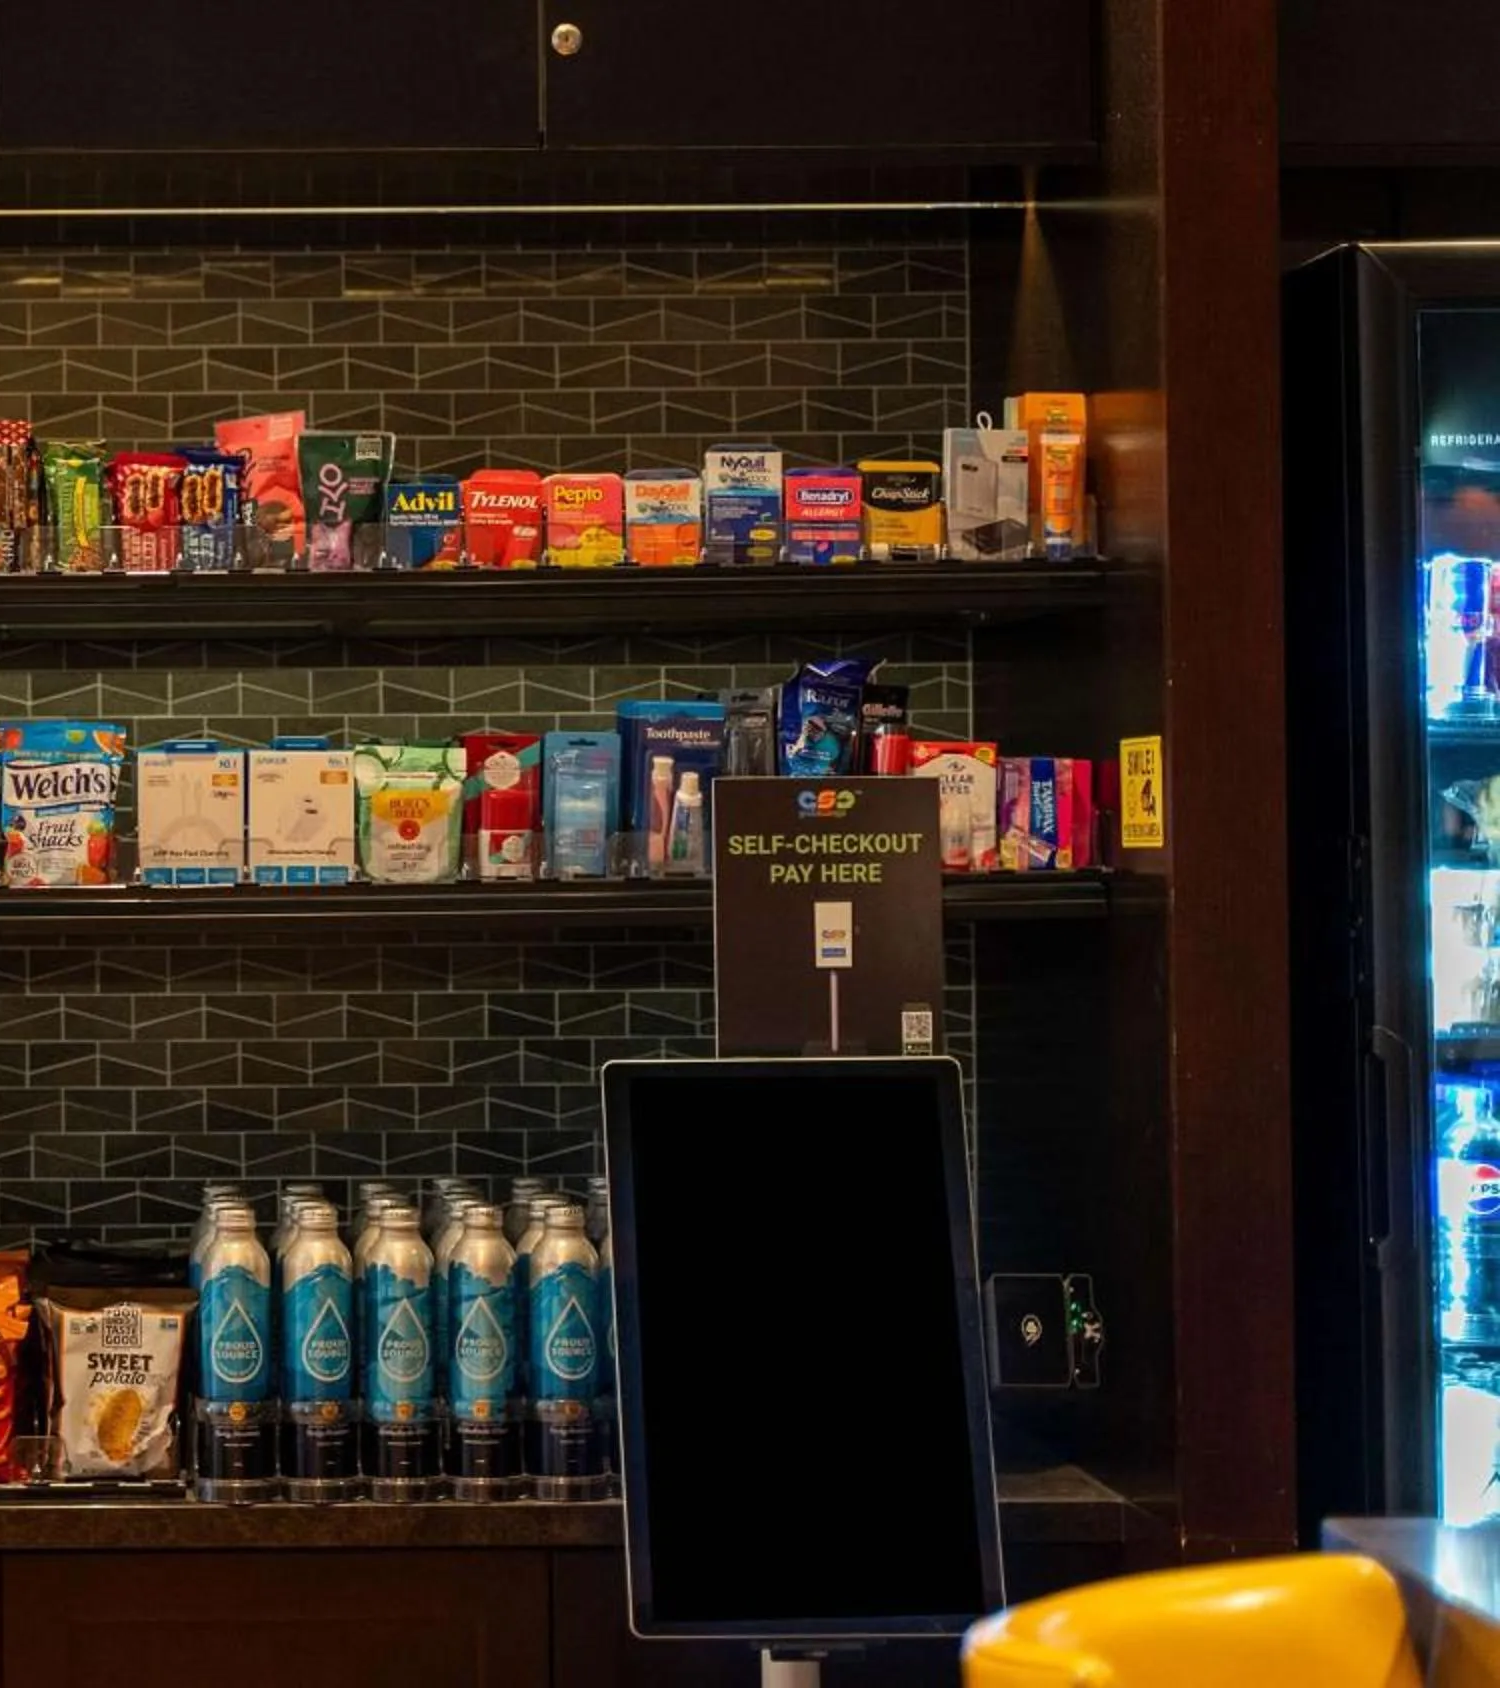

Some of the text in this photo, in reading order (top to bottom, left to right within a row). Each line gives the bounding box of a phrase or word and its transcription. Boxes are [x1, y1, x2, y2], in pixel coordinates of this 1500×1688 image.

[720, 456, 765, 471] NyQuil
[469, 491, 539, 509] TYLENOL
[554, 486, 603, 503] Pepto
[635, 483, 690, 499] DayQuil
[801, 490, 849, 504] Benadryl
[393, 491, 455, 512] Advil
[862, 703, 903, 717] Gillette
[646, 727, 711, 742] Toothpaste
[10, 767, 106, 800] Welch's
[1041, 779, 1056, 834] TAMPAX
[38, 818, 77, 836] Fruit
[28, 830, 84, 848] Snacks
[728, 833, 923, 855] SELF-CHECKOUT
[770, 863, 882, 884] PAY HERE
[87, 1353, 153, 1373] SWEET
[88, 1371, 147, 1388] potato
